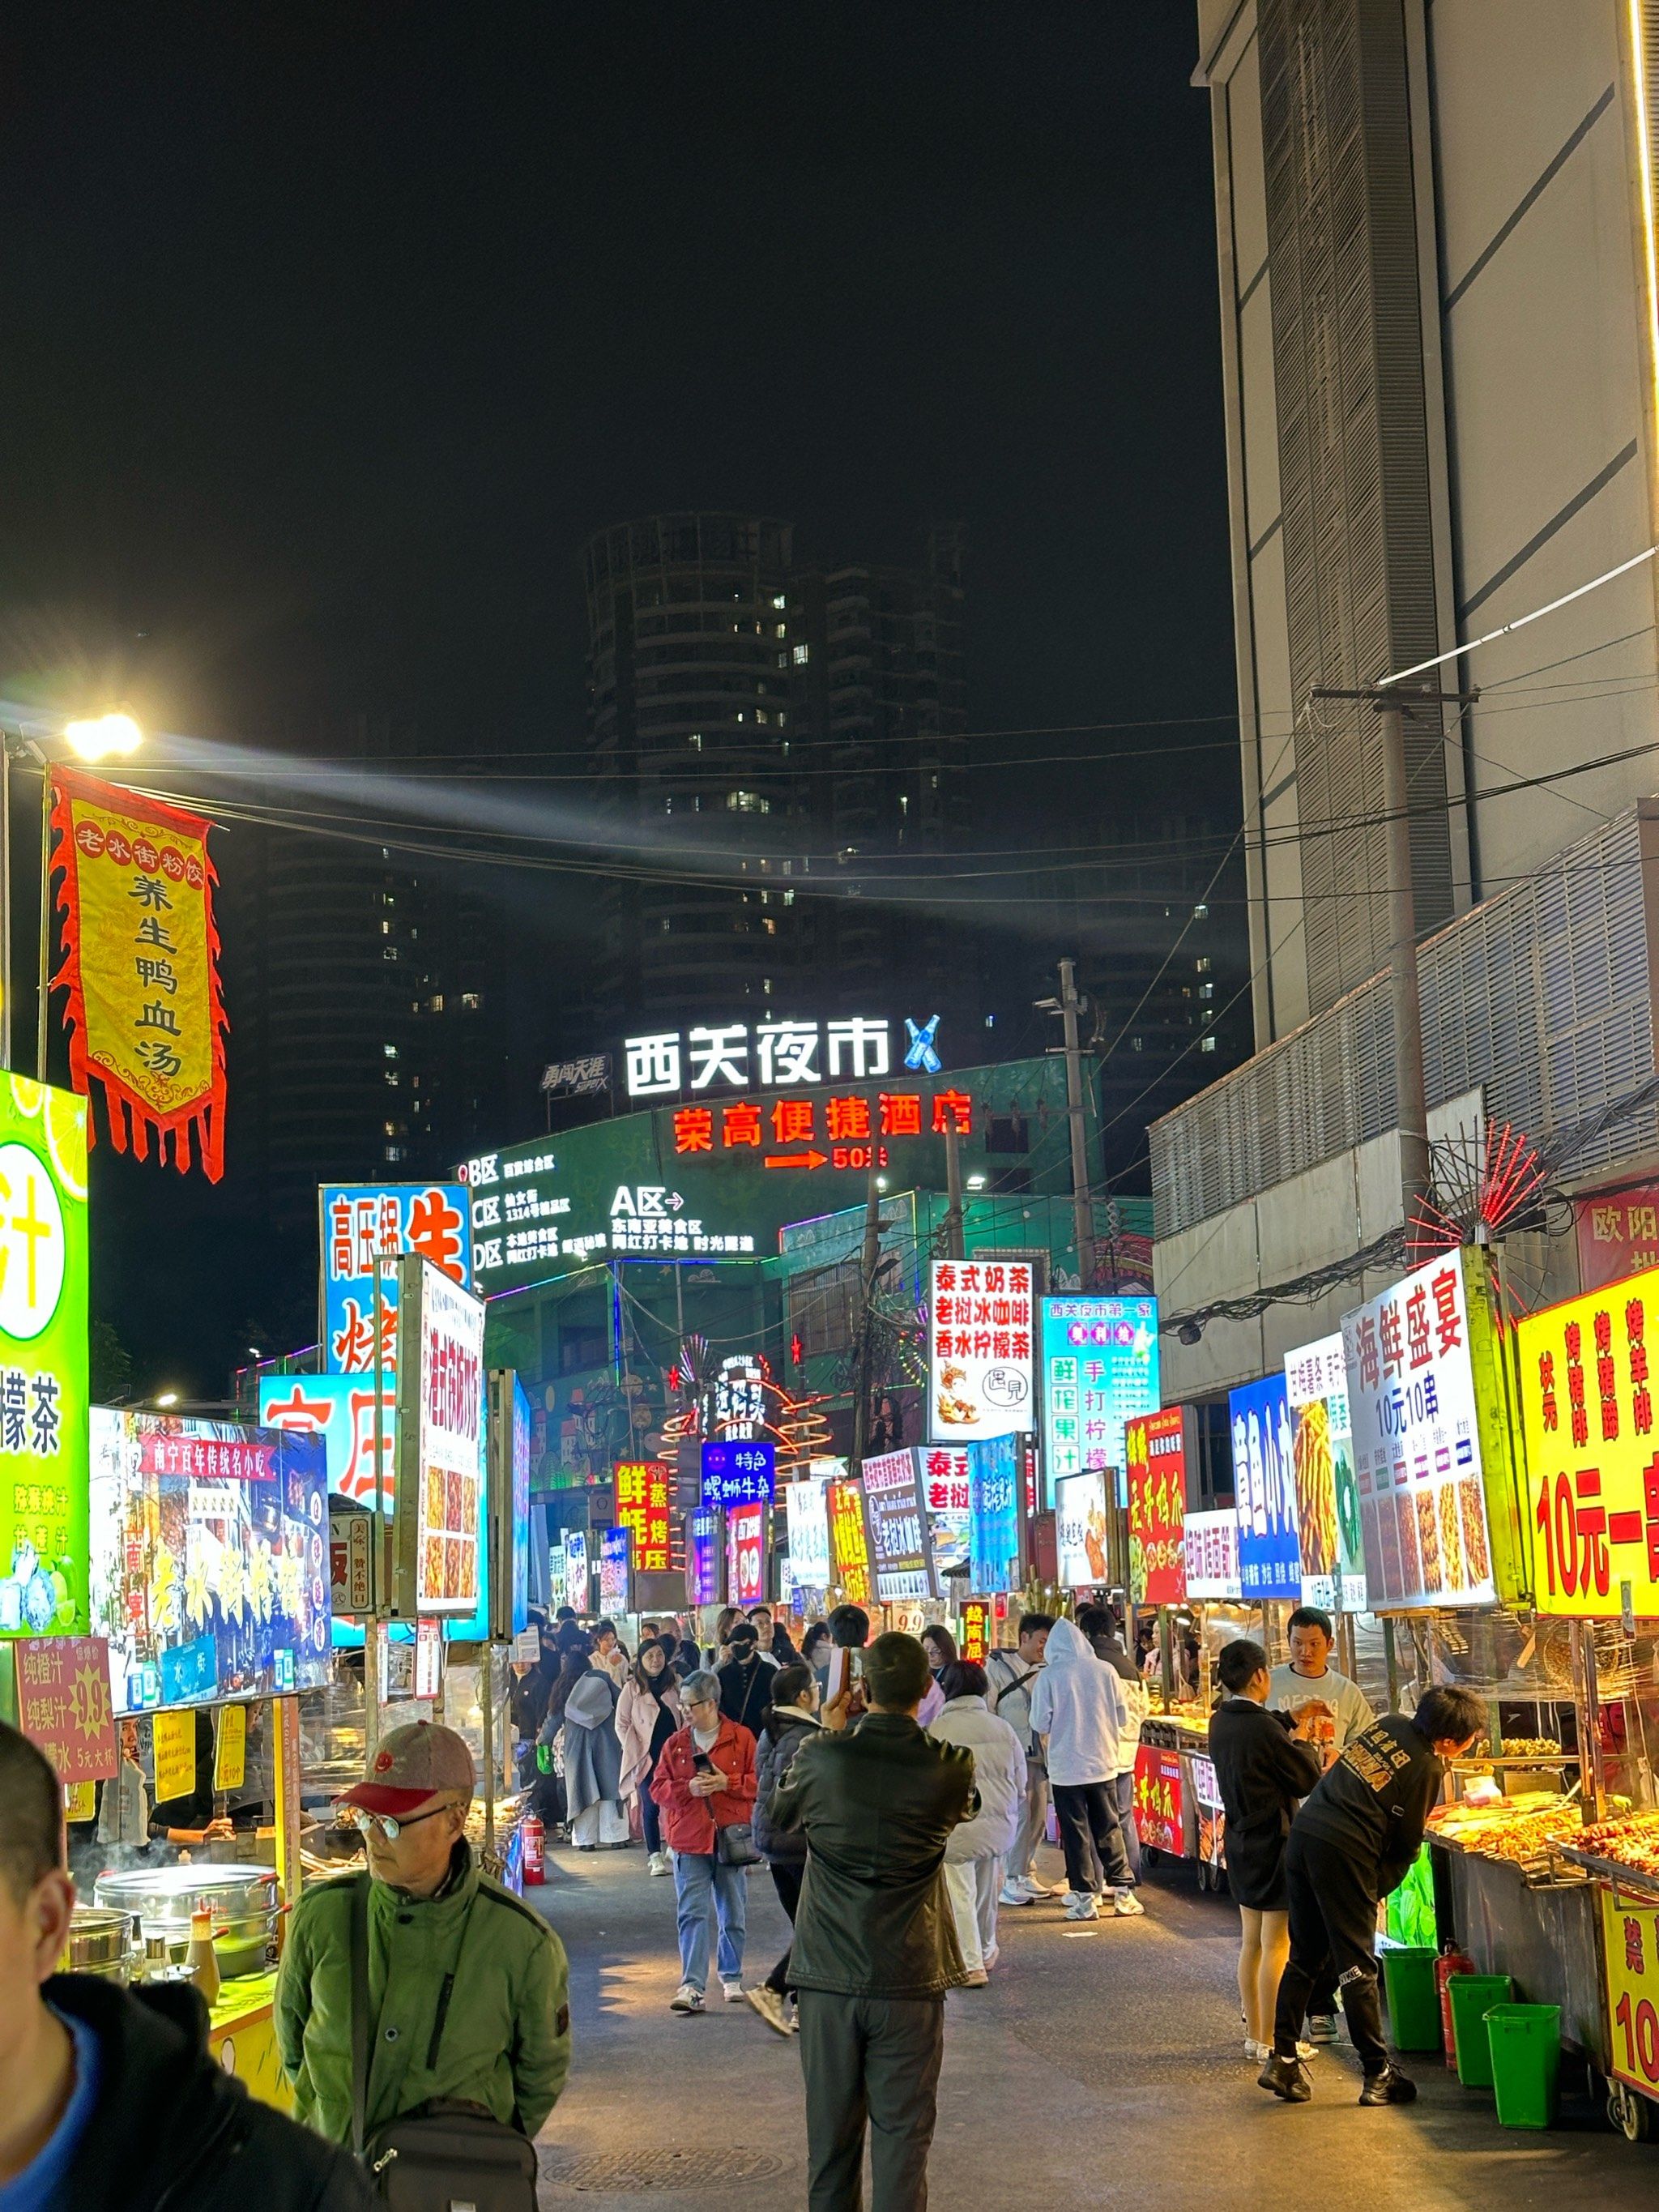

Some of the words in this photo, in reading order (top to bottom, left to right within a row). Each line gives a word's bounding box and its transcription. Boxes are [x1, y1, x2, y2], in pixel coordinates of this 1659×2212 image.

[79, 827, 203, 884] 老水街粉饺
[129, 876, 181, 1076] 养生鸭血汤
[542, 1056, 606, 1089] 勇闯天涯
[625, 1018, 889, 1095] 西关夜市
[674, 1089, 971, 1153] 荣高便捷酒店
[468, 1154, 499, 1187] B区
[472, 1196, 501, 1228] C区
[610, 1186, 667, 1216] A区
[612, 1218, 702, 1234] 东南亚美食区
[1592, 1205, 1657, 1243] 欧阳
[473, 1238, 503, 1271] D区
[936, 1264, 1030, 1294] 泰式奶茶
[936, 1296, 1030, 1327] 老挝冰咖啡
[1051, 1303, 1151, 1317] 西关夜市第一家
[936, 1330, 1030, 1360] 香水柠檬茶
[1355, 1267, 1462, 1394] 海鲜盛宴
[1053, 1359, 1077, 1470] 鲜榨果汁
[1085, 1361, 1107, 1469] 手打柠檬
[1375, 1370, 1439, 1437] 10元10串
[153, 1441, 266, 1476] 南宁百年传统名小吃
[736, 1450, 767, 1471] 特色
[23, 1651, 63, 1685] 纯橙汁
[27, 1696, 68, 1731] 纯梨汁
[77, 1680, 103, 1723] 9.9
[77, 1747, 114, 1769] 5元大杯
